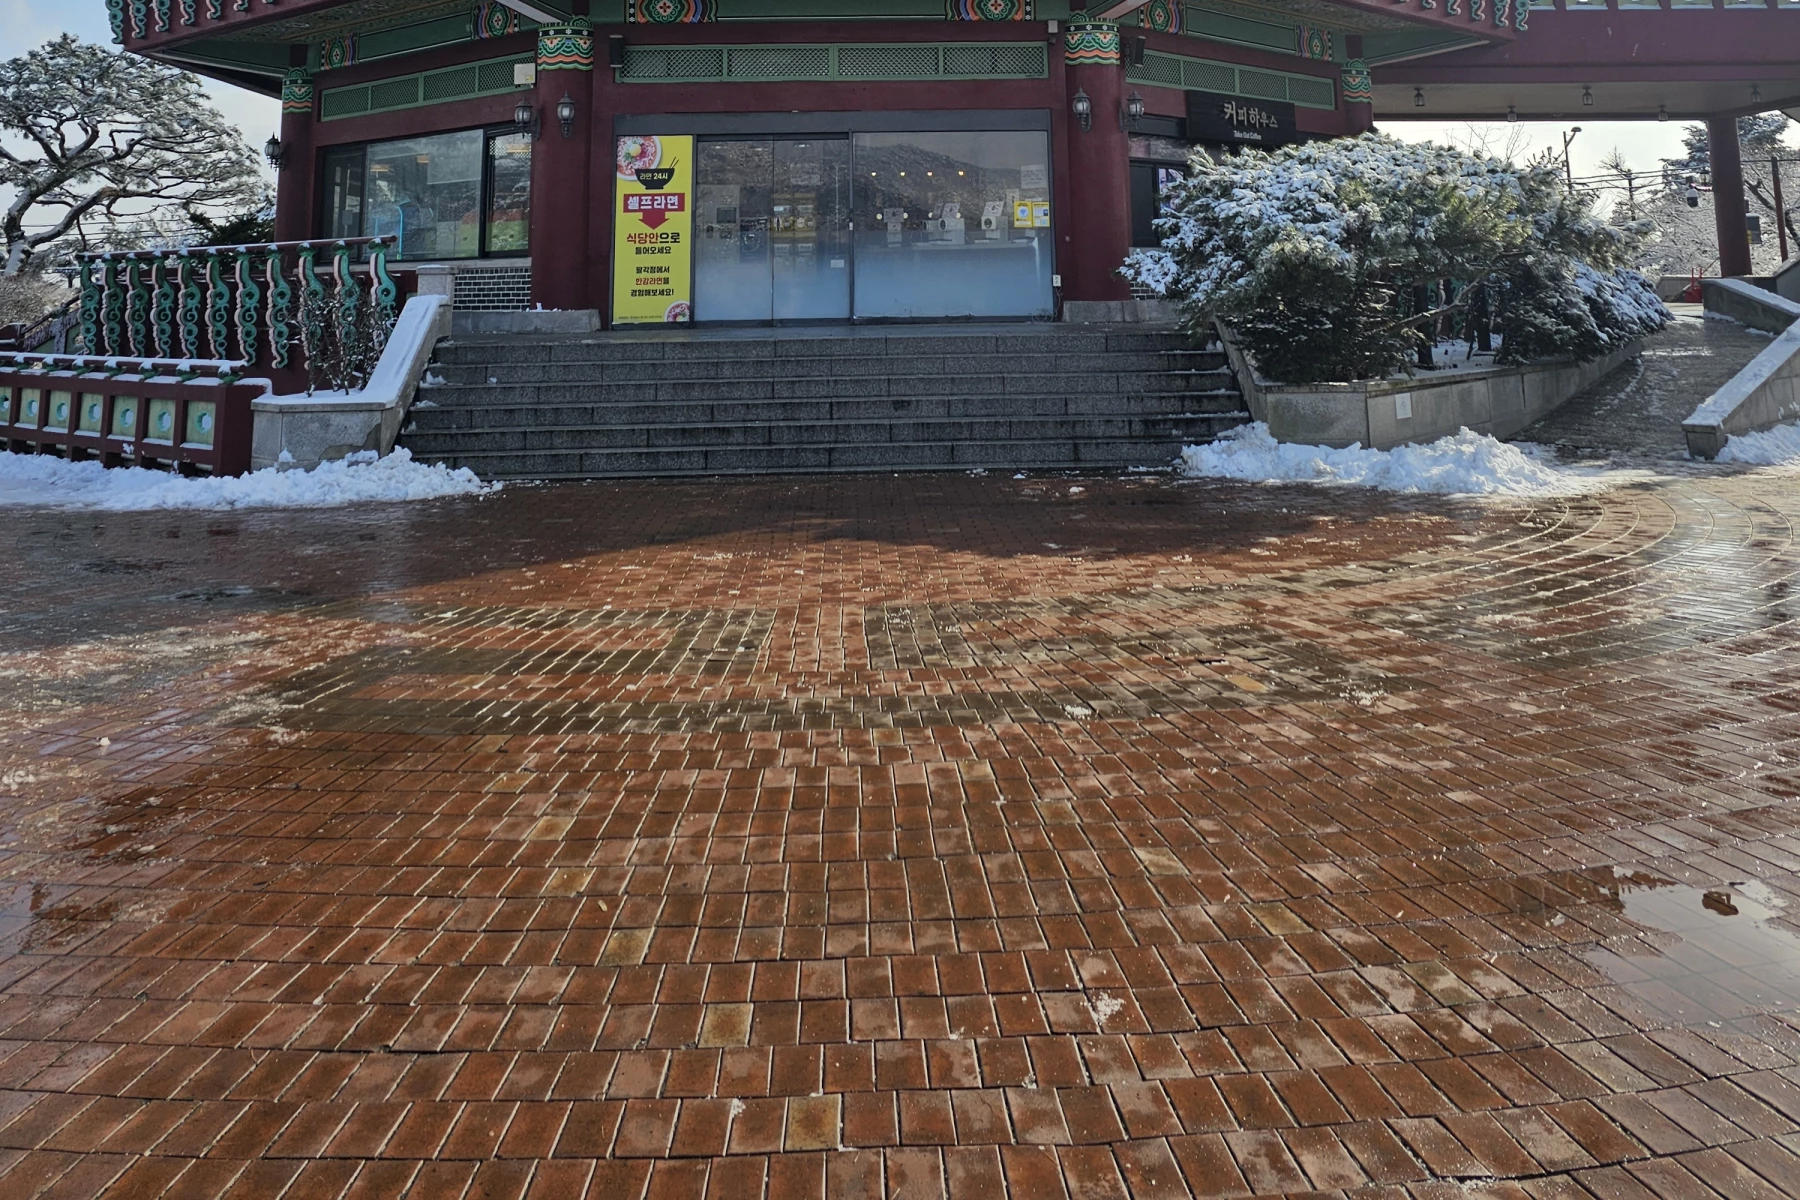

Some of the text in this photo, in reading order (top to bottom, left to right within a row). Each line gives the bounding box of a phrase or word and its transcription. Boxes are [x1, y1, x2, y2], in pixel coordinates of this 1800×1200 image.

[1223, 101, 1279, 129] 커피하우스
[639, 172, 668, 180] 라면 24시
[627, 195, 679, 210] 셀프라면
[626, 232, 681, 245] 식당안으로
[635, 246, 671, 255] 들어오세요
[635, 266, 670, 274] 팔각정에서
[635, 276, 670, 285] 한강라면을
[630, 288, 674, 297] 경험해보세요!
